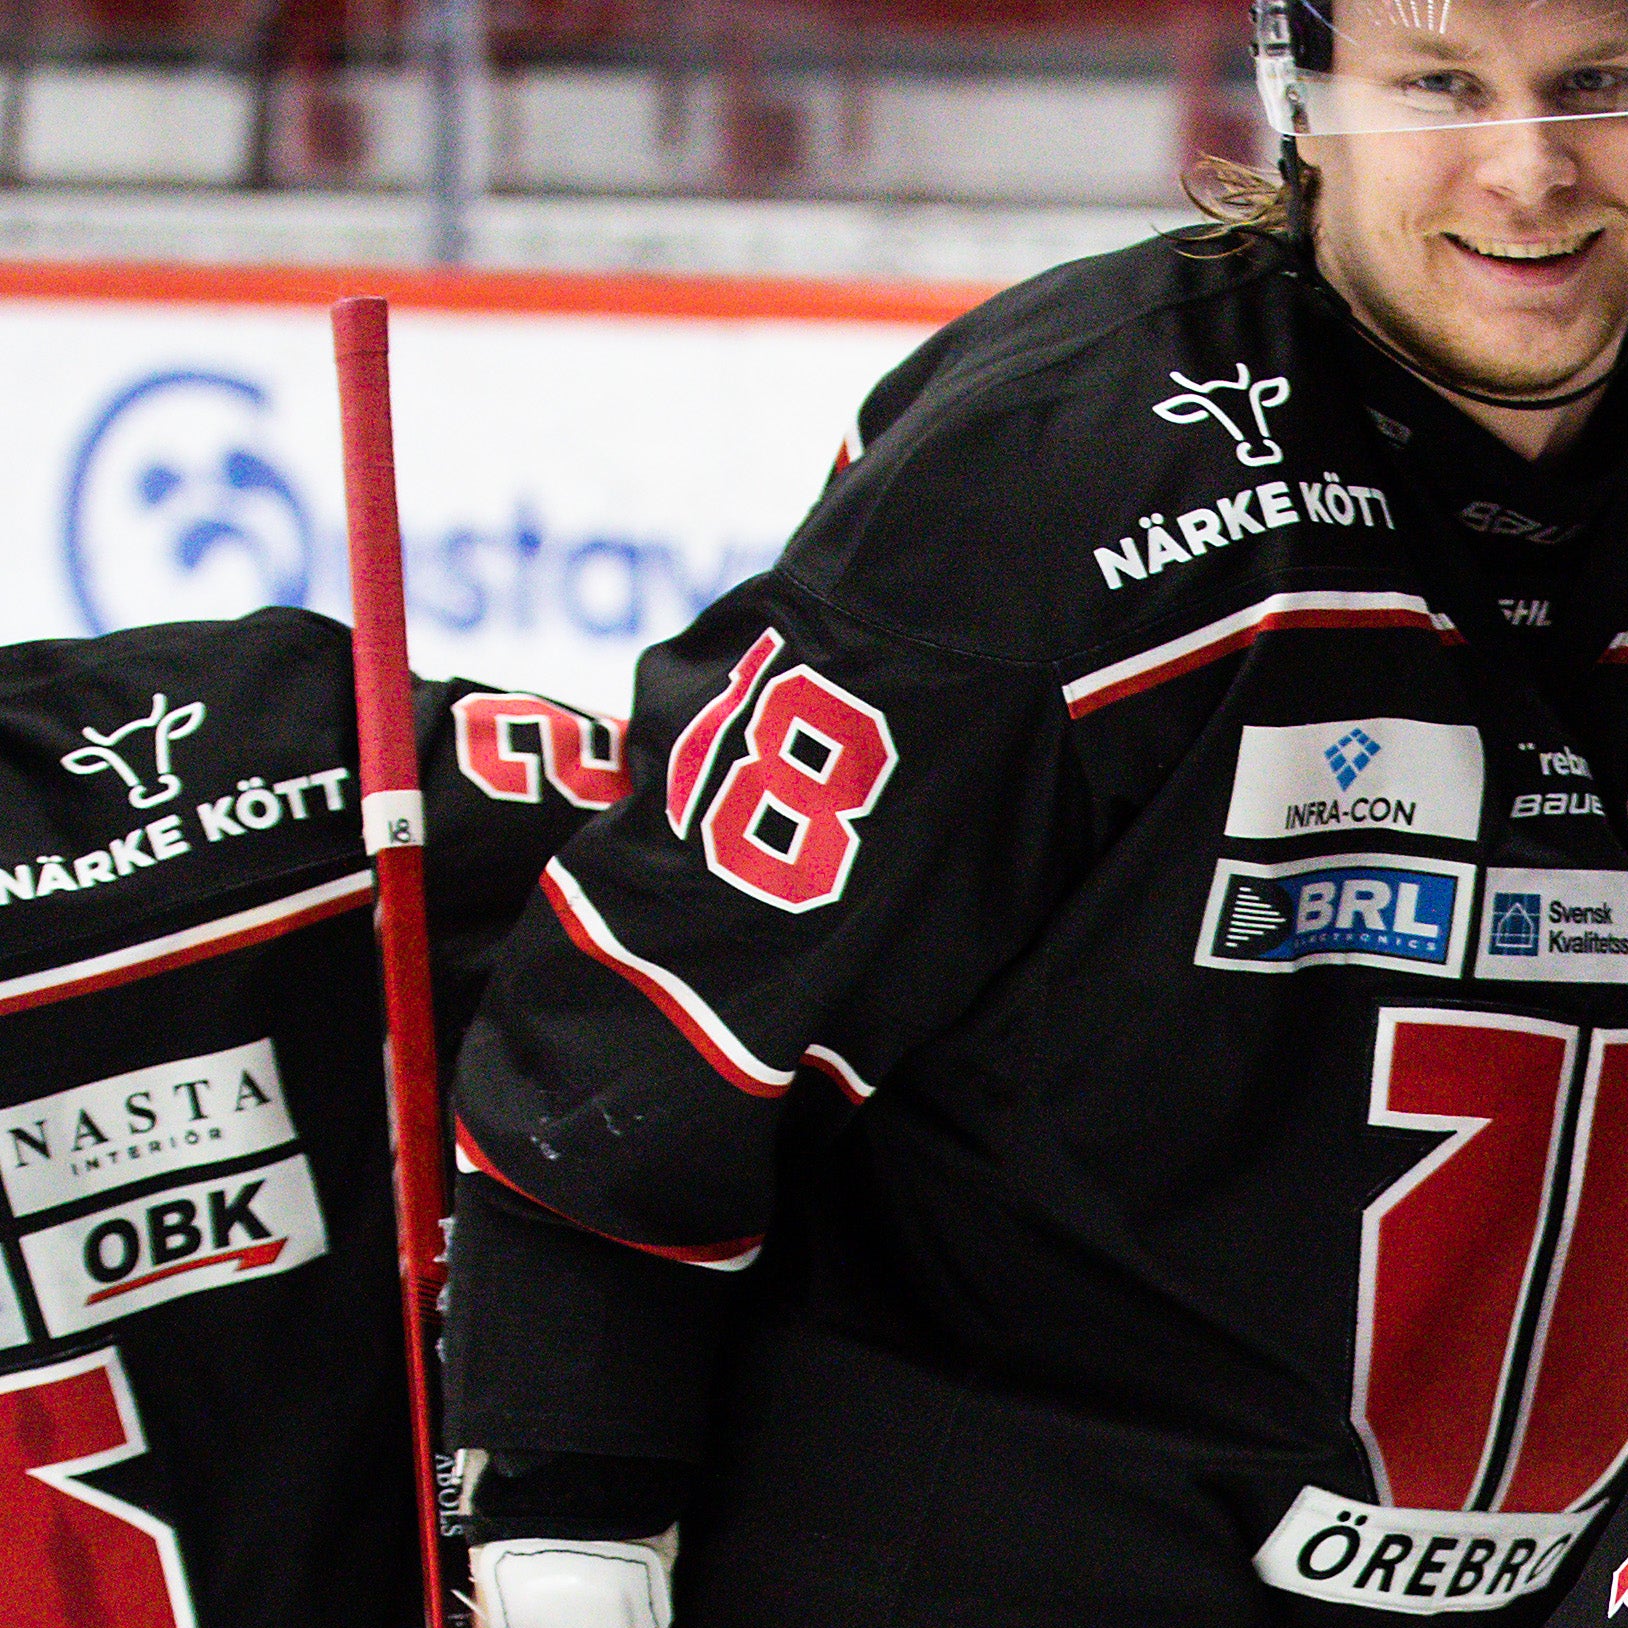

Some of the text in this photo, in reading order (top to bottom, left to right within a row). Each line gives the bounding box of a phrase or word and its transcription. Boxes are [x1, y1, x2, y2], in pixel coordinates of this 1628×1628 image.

[1092, 480, 1300, 590] NÄRKE
[666, 625, 900, 908] 18
[1284, 797, 1417, 831] INFRA-CON
[1509, 792, 1606, 819] BAUE
[0, 767, 351, 906] NÄRKE KÖTT
[1295, 878, 1439, 938] BRL
[1548, 900, 1614, 925] Svensk
[8, 1069, 272, 1169] NASTA
[83, 1178, 272, 1284] OBK
[1297, 1510, 1574, 1602] ÖREBRO
